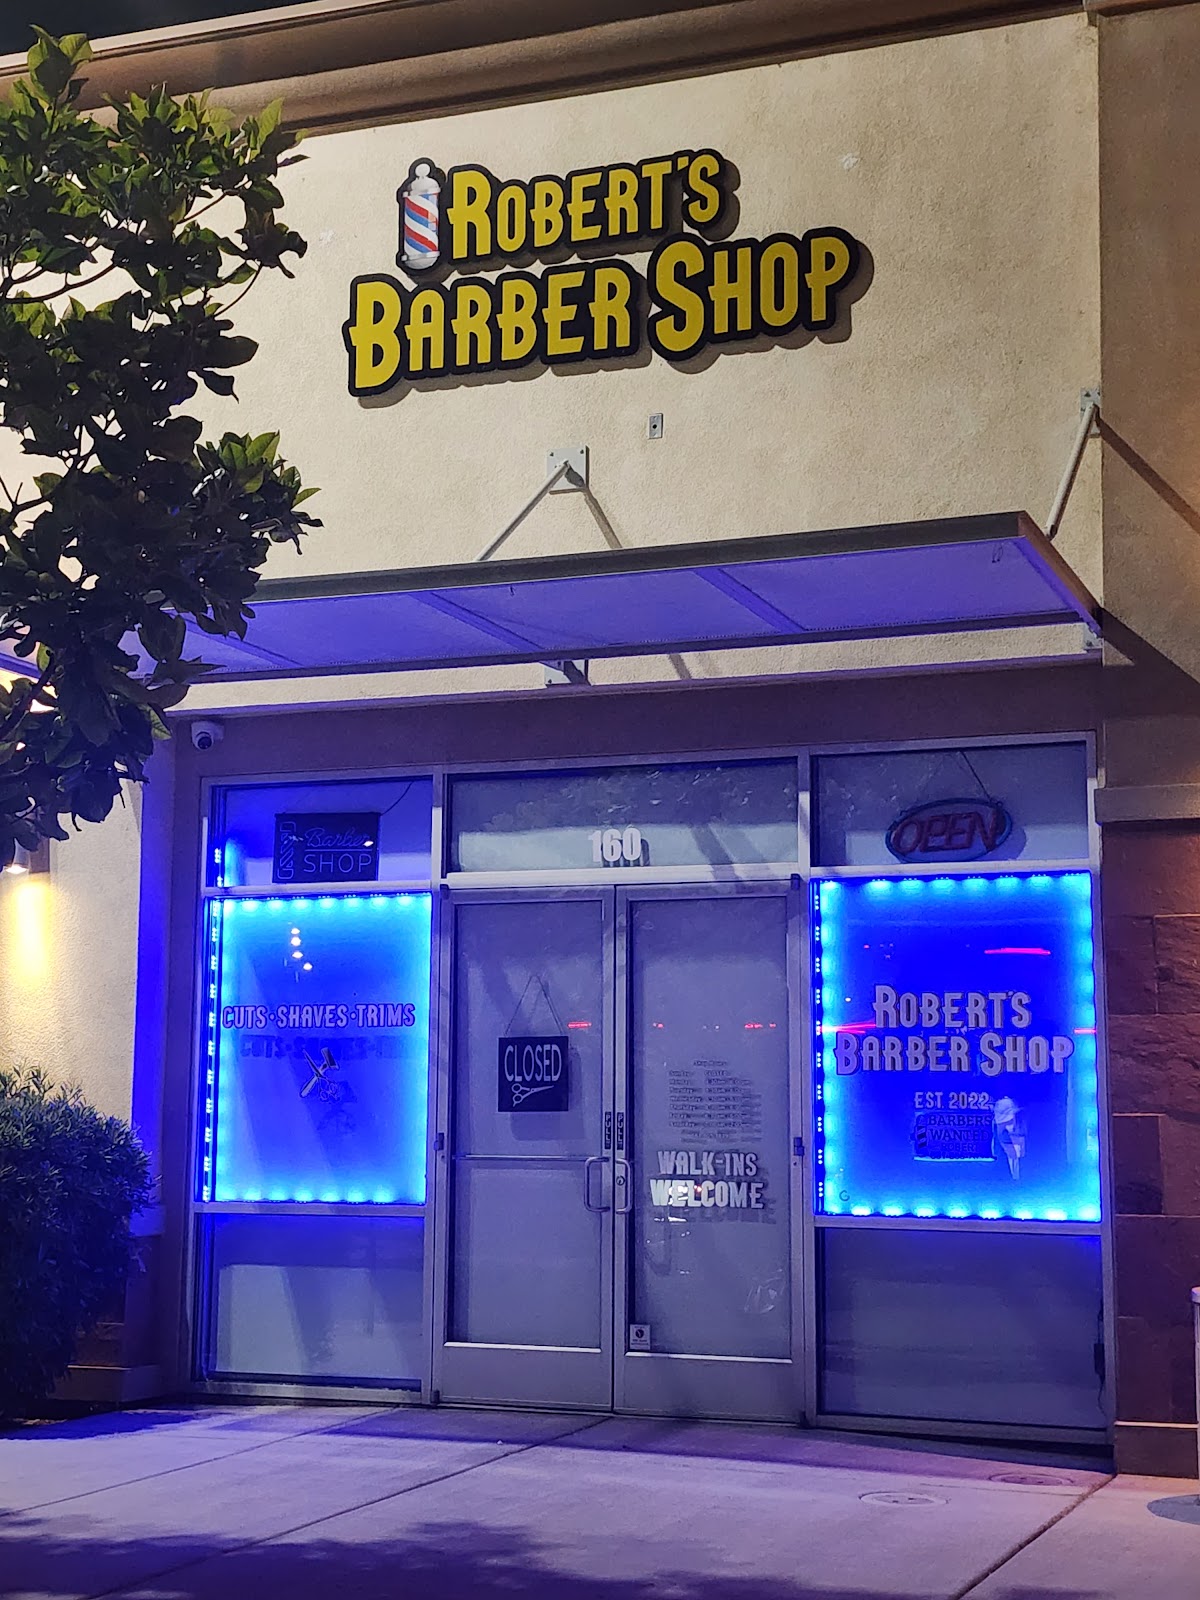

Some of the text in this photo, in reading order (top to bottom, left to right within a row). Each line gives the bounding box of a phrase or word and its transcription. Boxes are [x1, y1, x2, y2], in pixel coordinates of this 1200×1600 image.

[447, 153, 721, 260] ROBERT'S
[349, 235, 850, 389] BARBER SHOP
[305, 827, 371, 848] Barber
[588, 827, 642, 863] 160
[891, 807, 1000, 856] OPEN
[303, 853, 372, 873] SHOP
[873, 984, 1031, 1029] ROBERT'S
[504, 1043, 562, 1082] CLOSED
[833, 1031, 1075, 1077] BARBER SHOP
[948, 1091, 990, 1110] 2022
[929, 1115, 993, 1126] BARBERS
[930, 1129, 991, 1141] WANTED
[657, 1150, 758, 1176] WALK-INS
[650, 1179, 764, 1209] WELCOME
